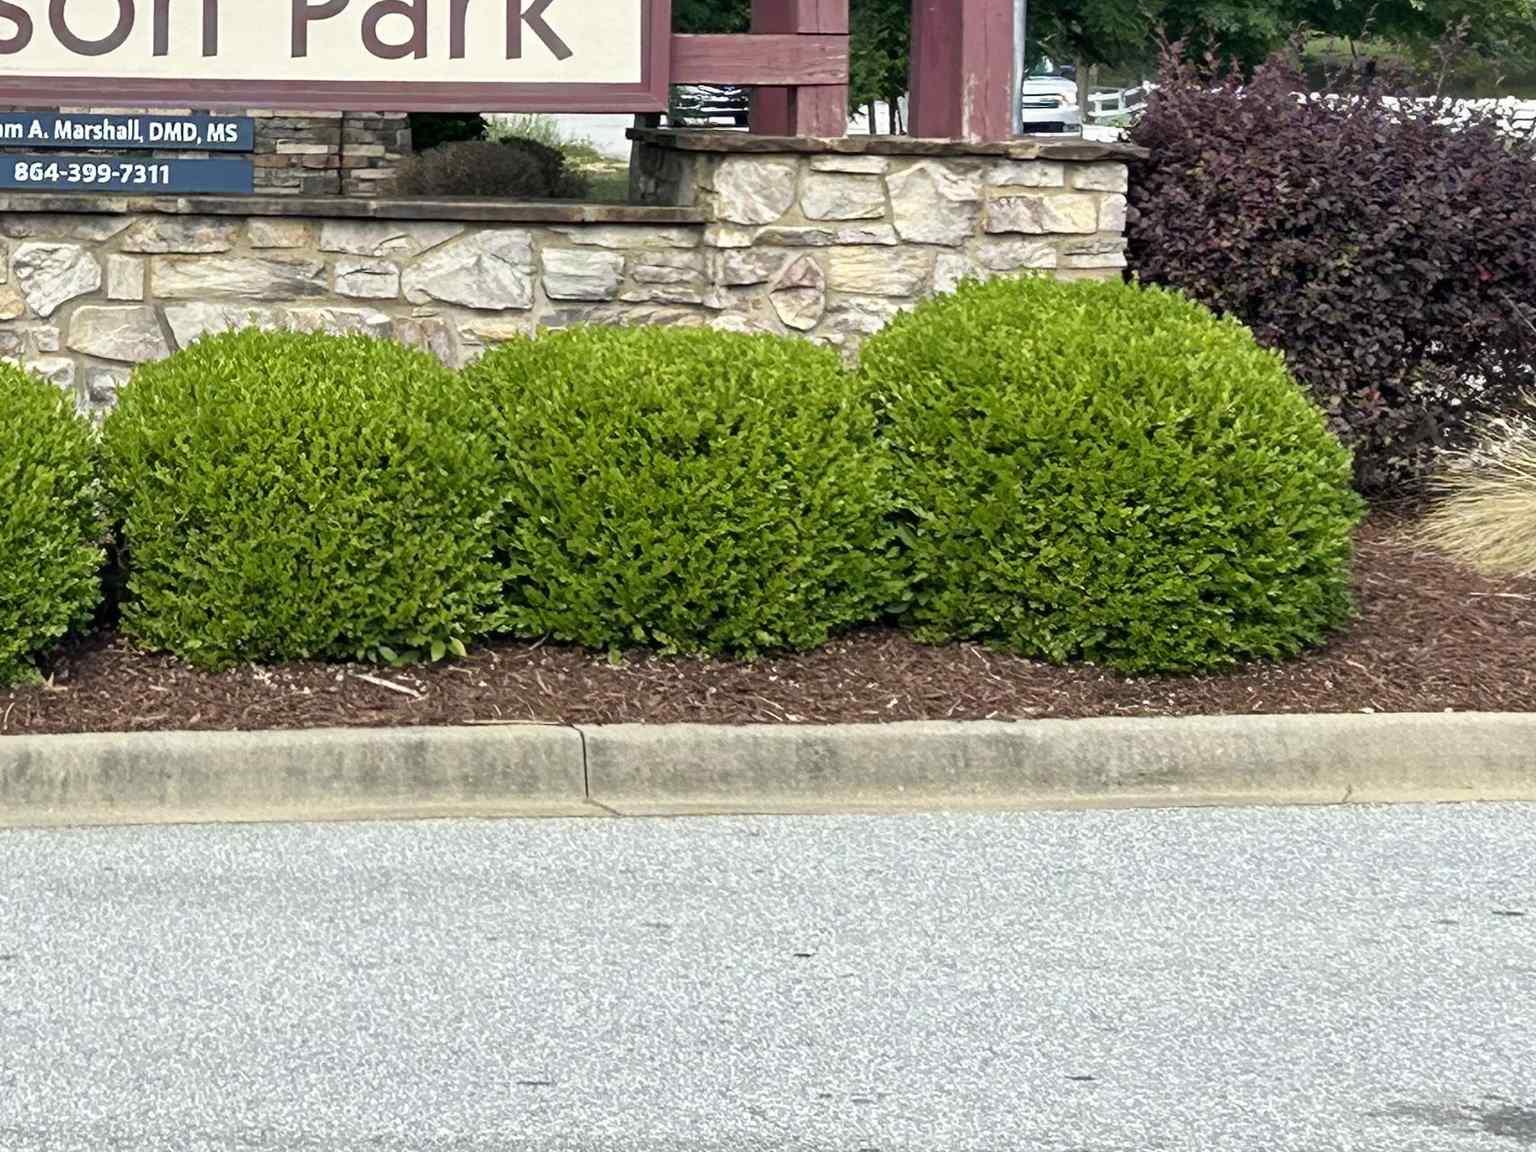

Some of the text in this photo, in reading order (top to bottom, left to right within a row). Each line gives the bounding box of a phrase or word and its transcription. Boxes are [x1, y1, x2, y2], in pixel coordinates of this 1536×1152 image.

[27, 119, 50, 139] A.
[54, 118, 145, 144] Marshall,
[149, 121, 202, 145] DMD,
[206, 123, 238, 143] MS
[14, 162, 169, 184] 864-399-7311
